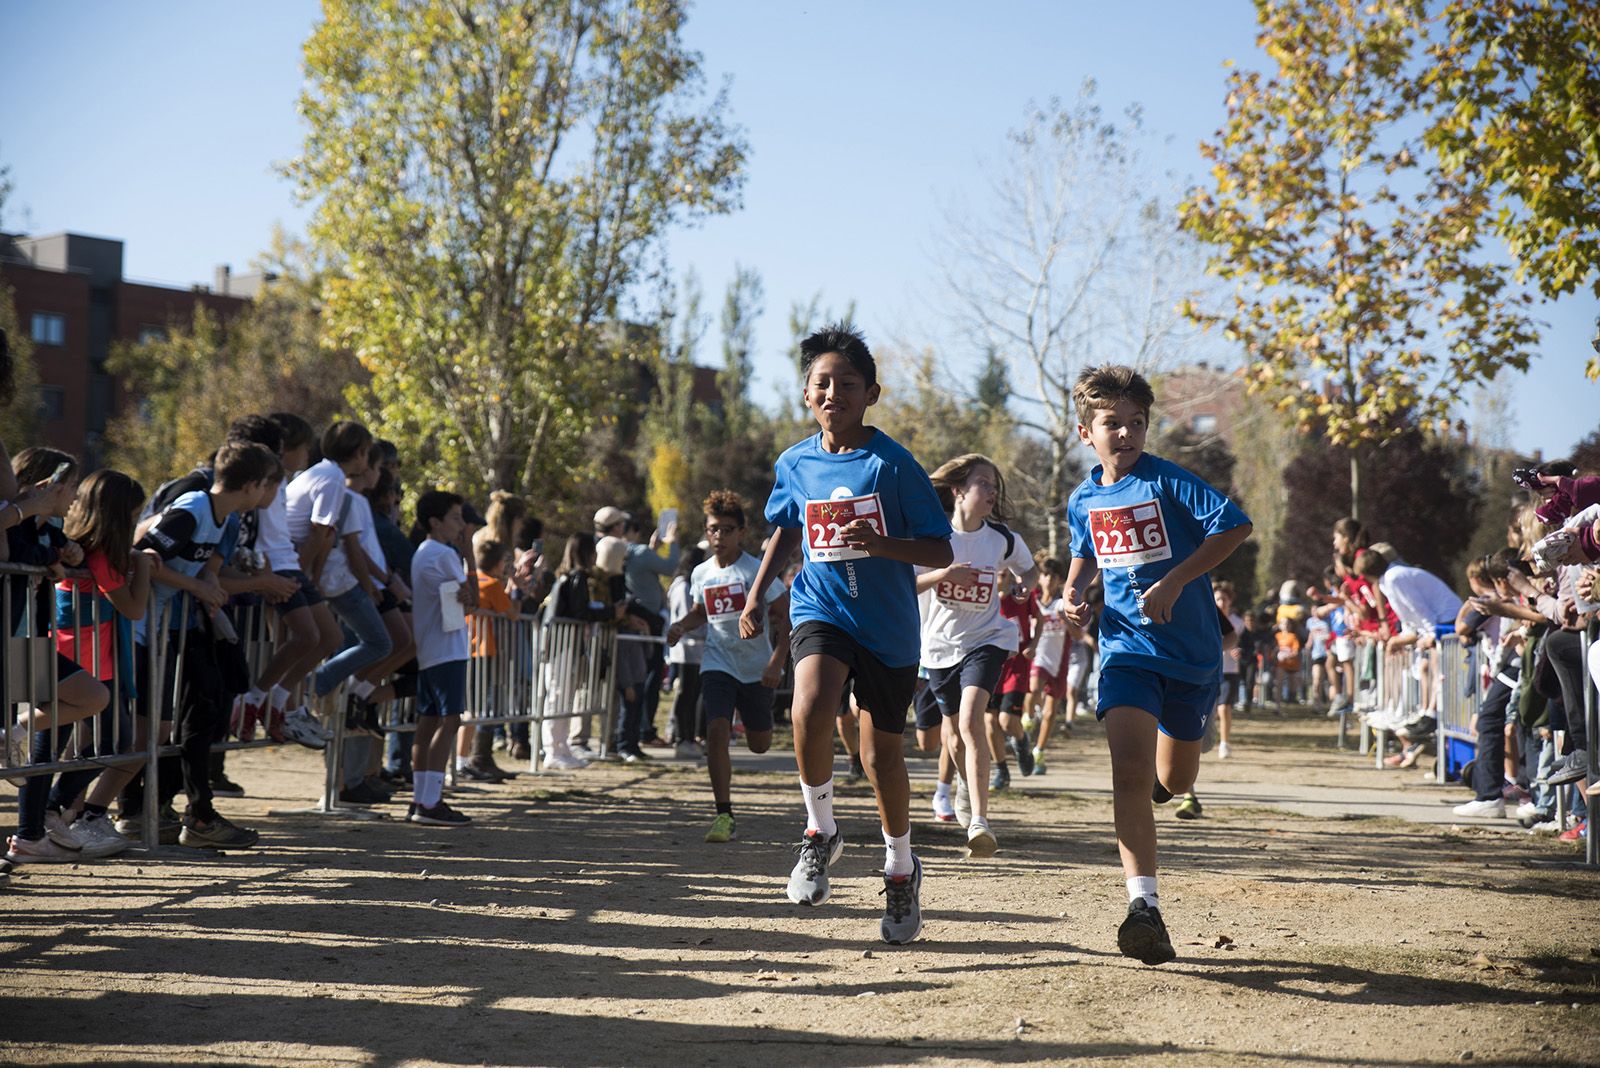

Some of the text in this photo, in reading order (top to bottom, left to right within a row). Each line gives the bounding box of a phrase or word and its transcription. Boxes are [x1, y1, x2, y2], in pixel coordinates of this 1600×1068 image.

[1096, 523, 1162, 553] 2216
[845, 562, 859, 598] GERBERT
[940, 581, 990, 603] 3643
[714, 597, 735, 613] 92
